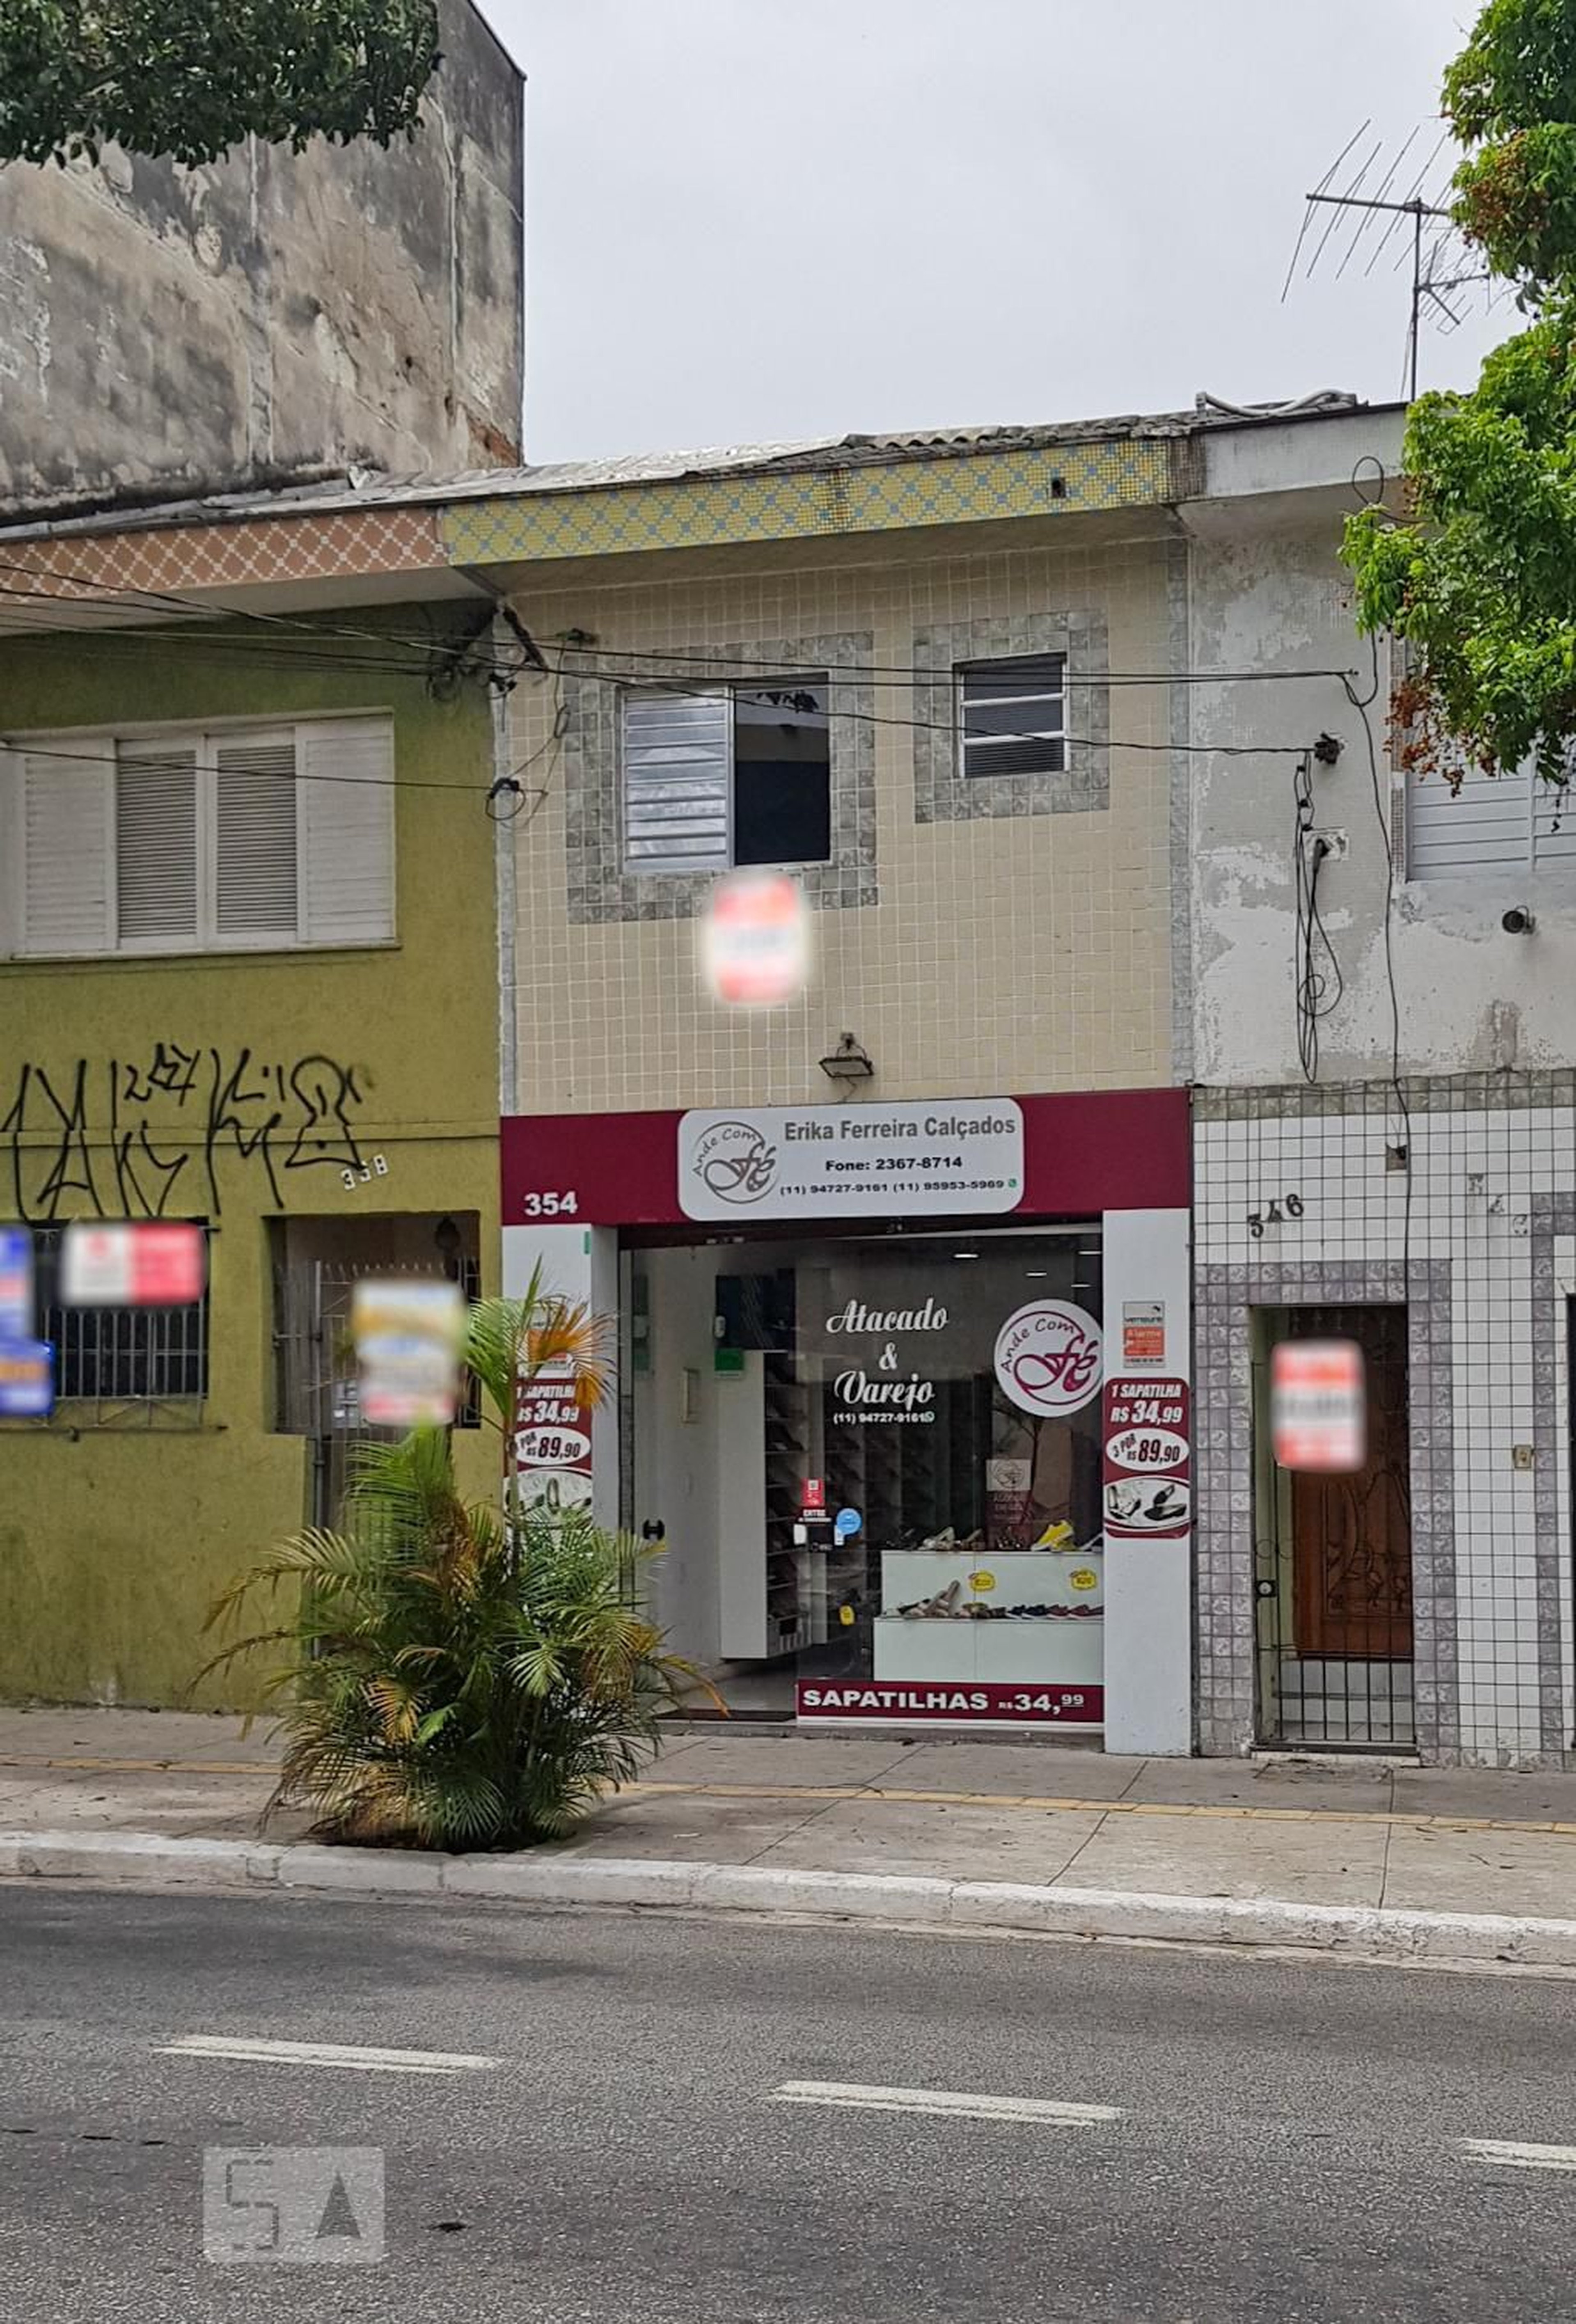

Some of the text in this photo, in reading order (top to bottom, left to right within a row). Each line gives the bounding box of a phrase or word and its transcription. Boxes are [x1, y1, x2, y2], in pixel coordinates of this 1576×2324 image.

[785, 1115, 1015, 1140] Erika Ferreira Calçados
[693, 1128, 757, 1177] Ande Com
[826, 1156, 963, 1171] Fone: 2367-8714
[780, 1186, 806, 1195] (11)
[893, 1182, 919, 1192] (11)
[525, 1191, 578, 1216] 354
[1247, 1194, 1304, 1237] 346
[826, 1298, 948, 1333] Atacado
[879, 1342, 898, 1370] &
[1001, 1318, 1074, 1373] Ande Com
[834, 1371, 936, 1411] Varejo
[1112, 1384, 1181, 1398] 1 SAPATILHA
[833, 1413, 856, 1424] (11)
[1131, 1400, 1183, 1426] 34,99
[538, 1436, 581, 1460] 89,90
[1138, 1439, 1180, 1465] 89,90
[803, 1690, 989, 1710] SAPATILHAS
